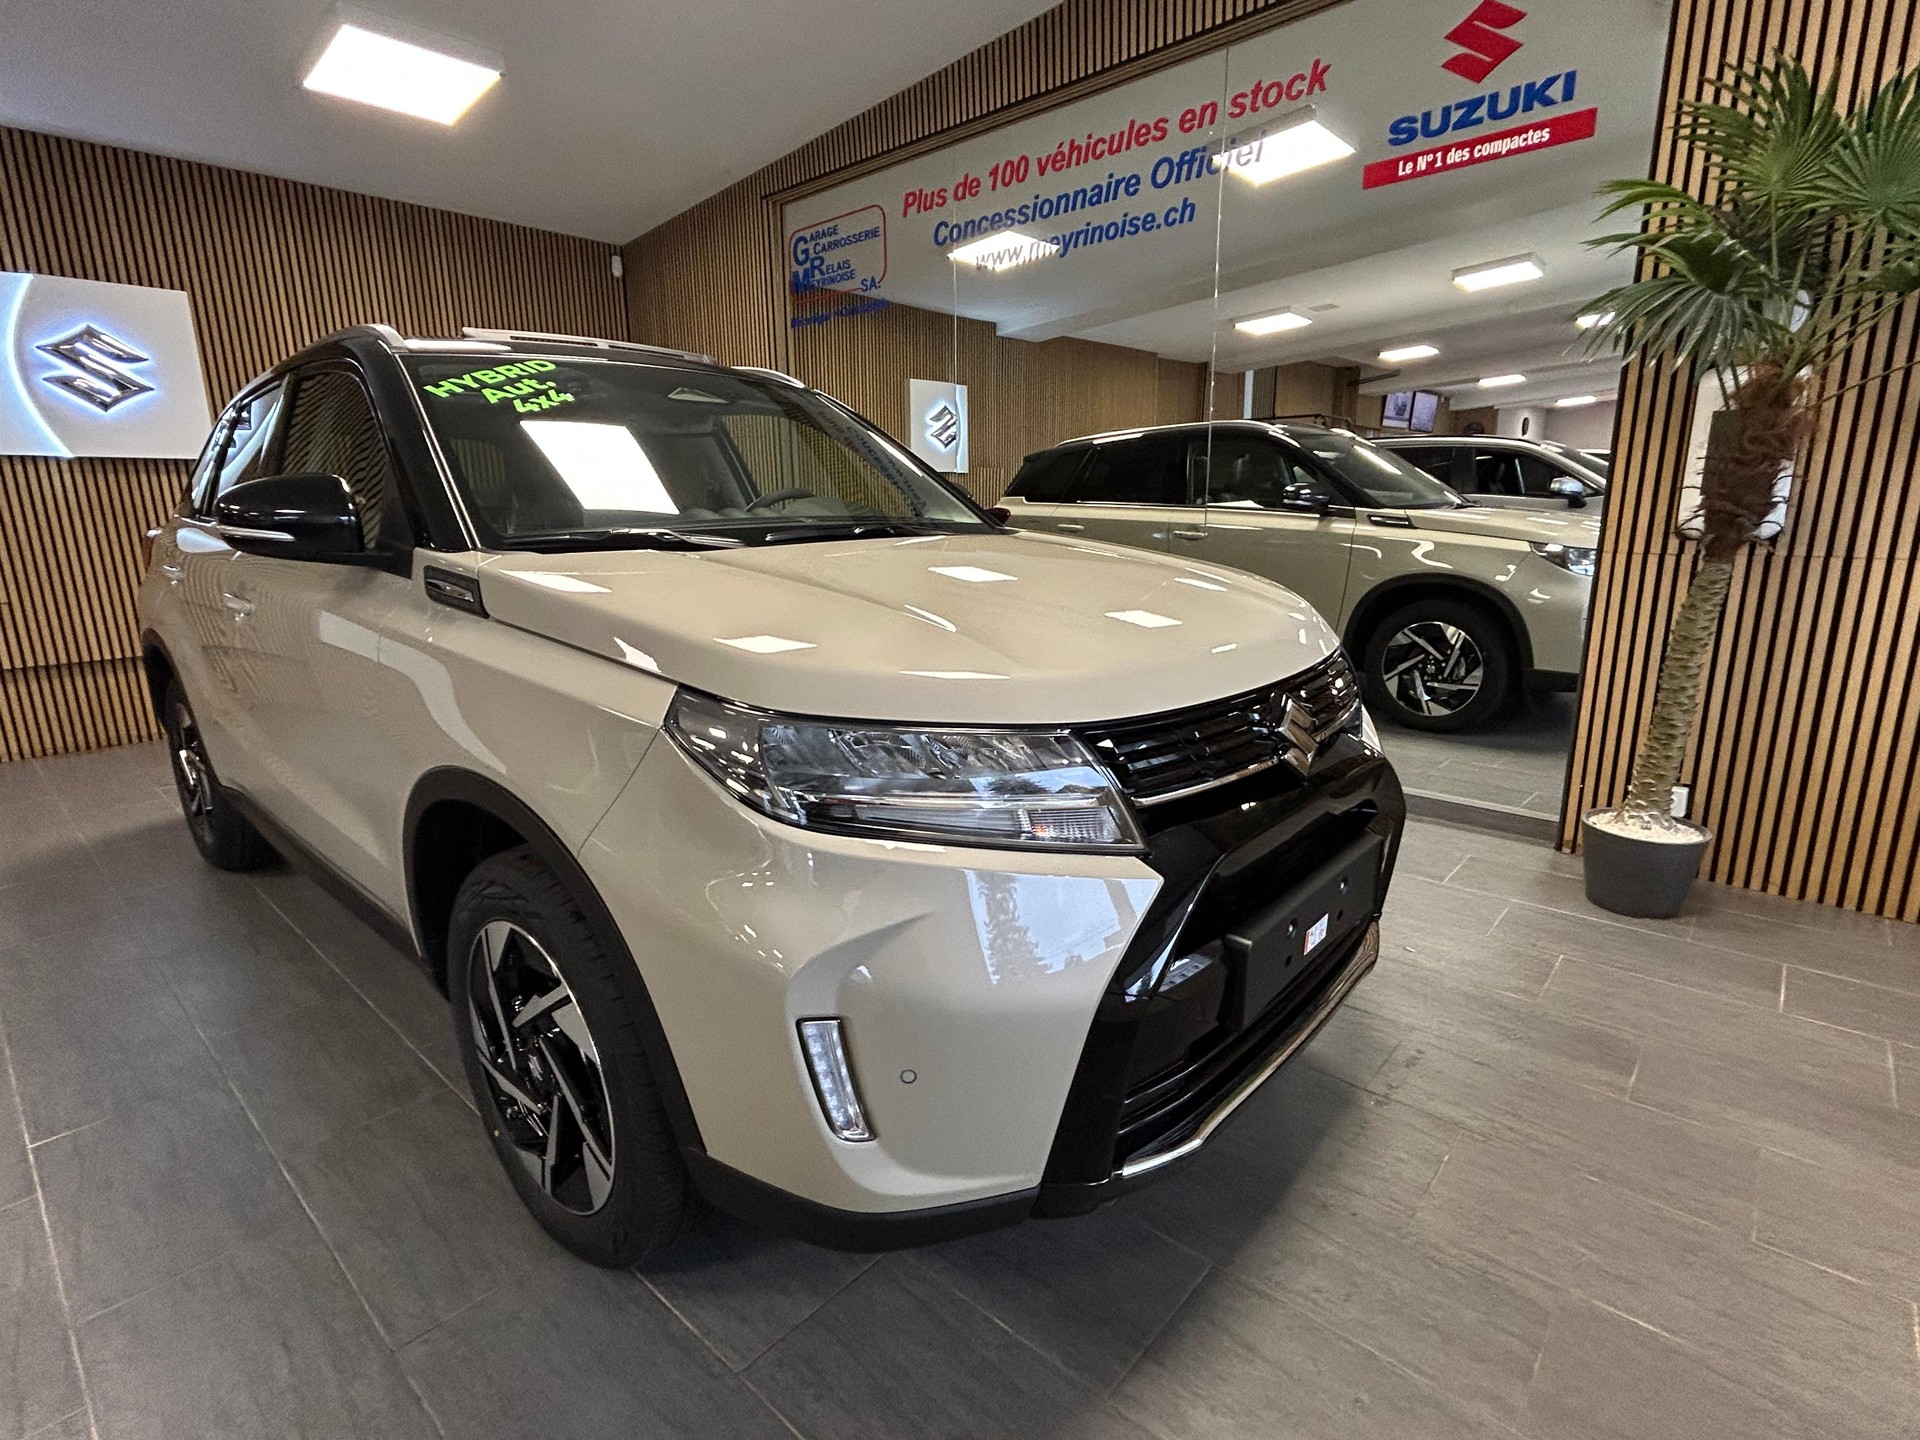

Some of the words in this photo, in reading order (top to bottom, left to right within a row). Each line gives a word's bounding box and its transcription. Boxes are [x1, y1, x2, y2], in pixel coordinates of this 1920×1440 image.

[1387, 69, 1578, 147] SUZUKI
[902, 186, 949, 218] Plus
[953, 172, 981, 202] de
[988, 154, 1030, 191] 100
[1036, 116, 1170, 177] véhicules
[1178, 100, 1219, 134] en
[1227, 57, 1332, 120] stock
[1398, 160, 1414, 177] Le
[1446, 147, 1470, 165] des
[1473, 126, 1550, 159] compactes
[933, 171, 1142, 248] Concessionnaire
[1150, 128, 1268, 190] Officiel
[792, 225, 839, 267] GARAGE
[813, 226, 881, 256] CARROSSERIE
[975, 197, 1196, 271] www.meyrinoise.ch
[810, 255, 852, 279] RELAIS
[423, 359, 557, 399] HYBRID
[480, 377, 557, 405] Aut.
